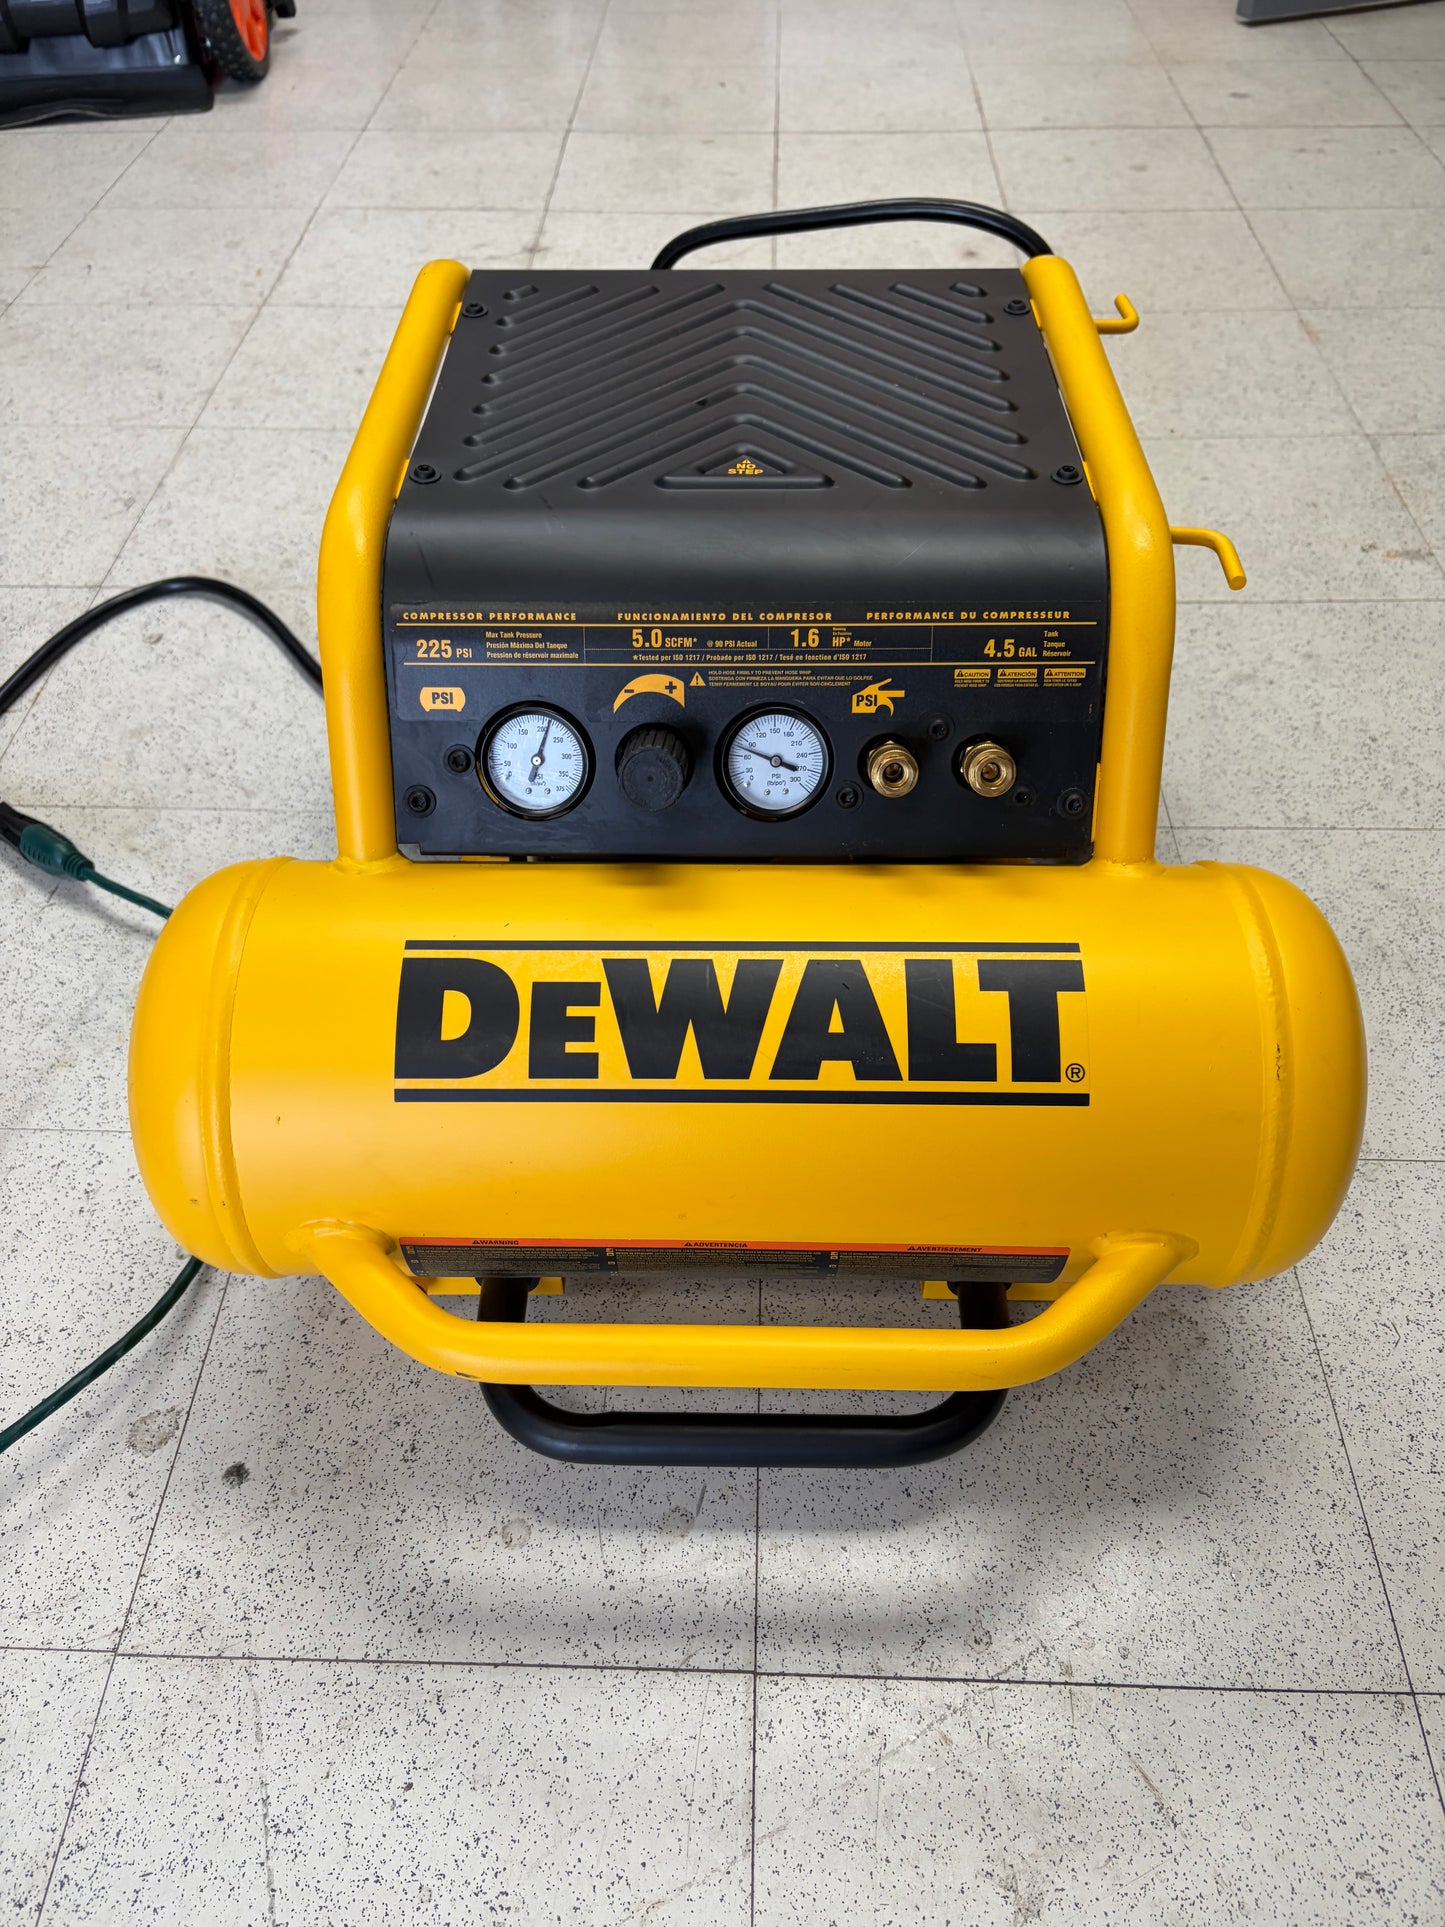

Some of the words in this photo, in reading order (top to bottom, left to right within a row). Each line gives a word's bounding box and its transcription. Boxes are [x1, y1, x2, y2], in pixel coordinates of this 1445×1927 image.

[402, 612, 484, 621] COMPRESSOR
[489, 612, 578, 621] PERFORMANCE
[617, 612, 726, 621] FUNCIONAMIENTO
[732, 612, 754, 621] DEL
[759, 612, 833, 621] COMPRESOR
[866, 611, 955, 621] PERFORMANCE
[960, 611, 977, 620] DU
[982, 610, 1071, 620] COMPRESSEUR
[485, 631, 499, 639] Max
[500, 631, 515, 639] Tank
[515, 631, 543, 639] Pressure
[632, 628, 663, 648] 5.0
[790, 628, 820, 648] 1.6
[1043, 630, 1059, 638] Tank
[486, 641, 509, 649] Presión
[534, 641, 545, 649] Del
[546, 642, 568, 650] Tanque
[706, 640, 714, 648] @
[714, 640, 724, 648] 90
[724, 640, 735, 648] PSI
[736, 640, 758, 648] Actual
[853, 640, 872, 648] Motor
[983, 638, 1016, 658] 4.5
[1018, 647, 1038, 658] GAL
[1043, 640, 1066, 649] Tanque
[416, 639, 453, 659] 225
[456, 648, 473, 659] PSI
[486, 651, 513, 659] Pression
[513, 651, 521, 659] de
[431, 692, 454, 704] PSI
[855, 694, 878, 707] PSI
[553, 736, 564, 744] 250
[394, 957, 1087, 1083] DEWALT
